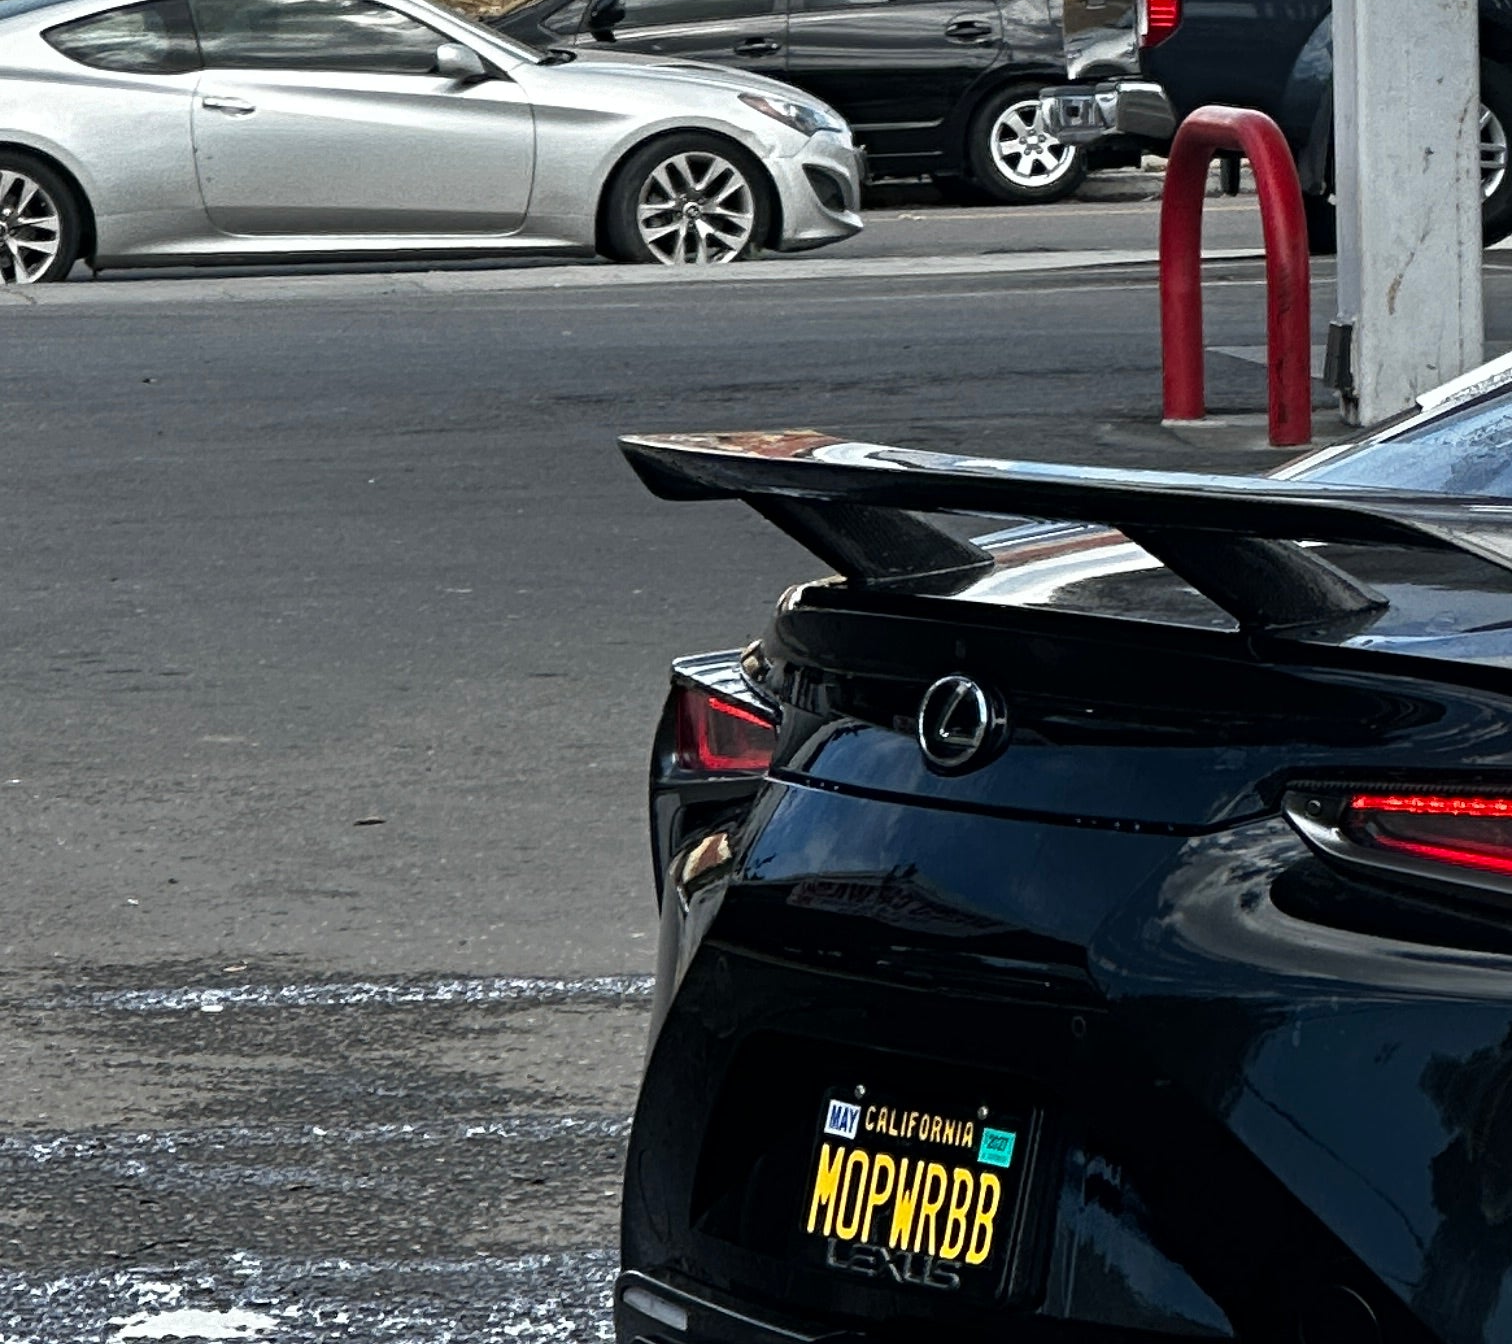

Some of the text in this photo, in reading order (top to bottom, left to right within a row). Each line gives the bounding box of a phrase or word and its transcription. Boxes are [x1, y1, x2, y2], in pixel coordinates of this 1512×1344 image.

[828, 1103, 858, 1133] MAY
[865, 1105, 974, 1147] CALIFORNIA
[807, 1141, 1000, 1265] MOPWRBB
[827, 1238, 960, 1289] LEXUS
